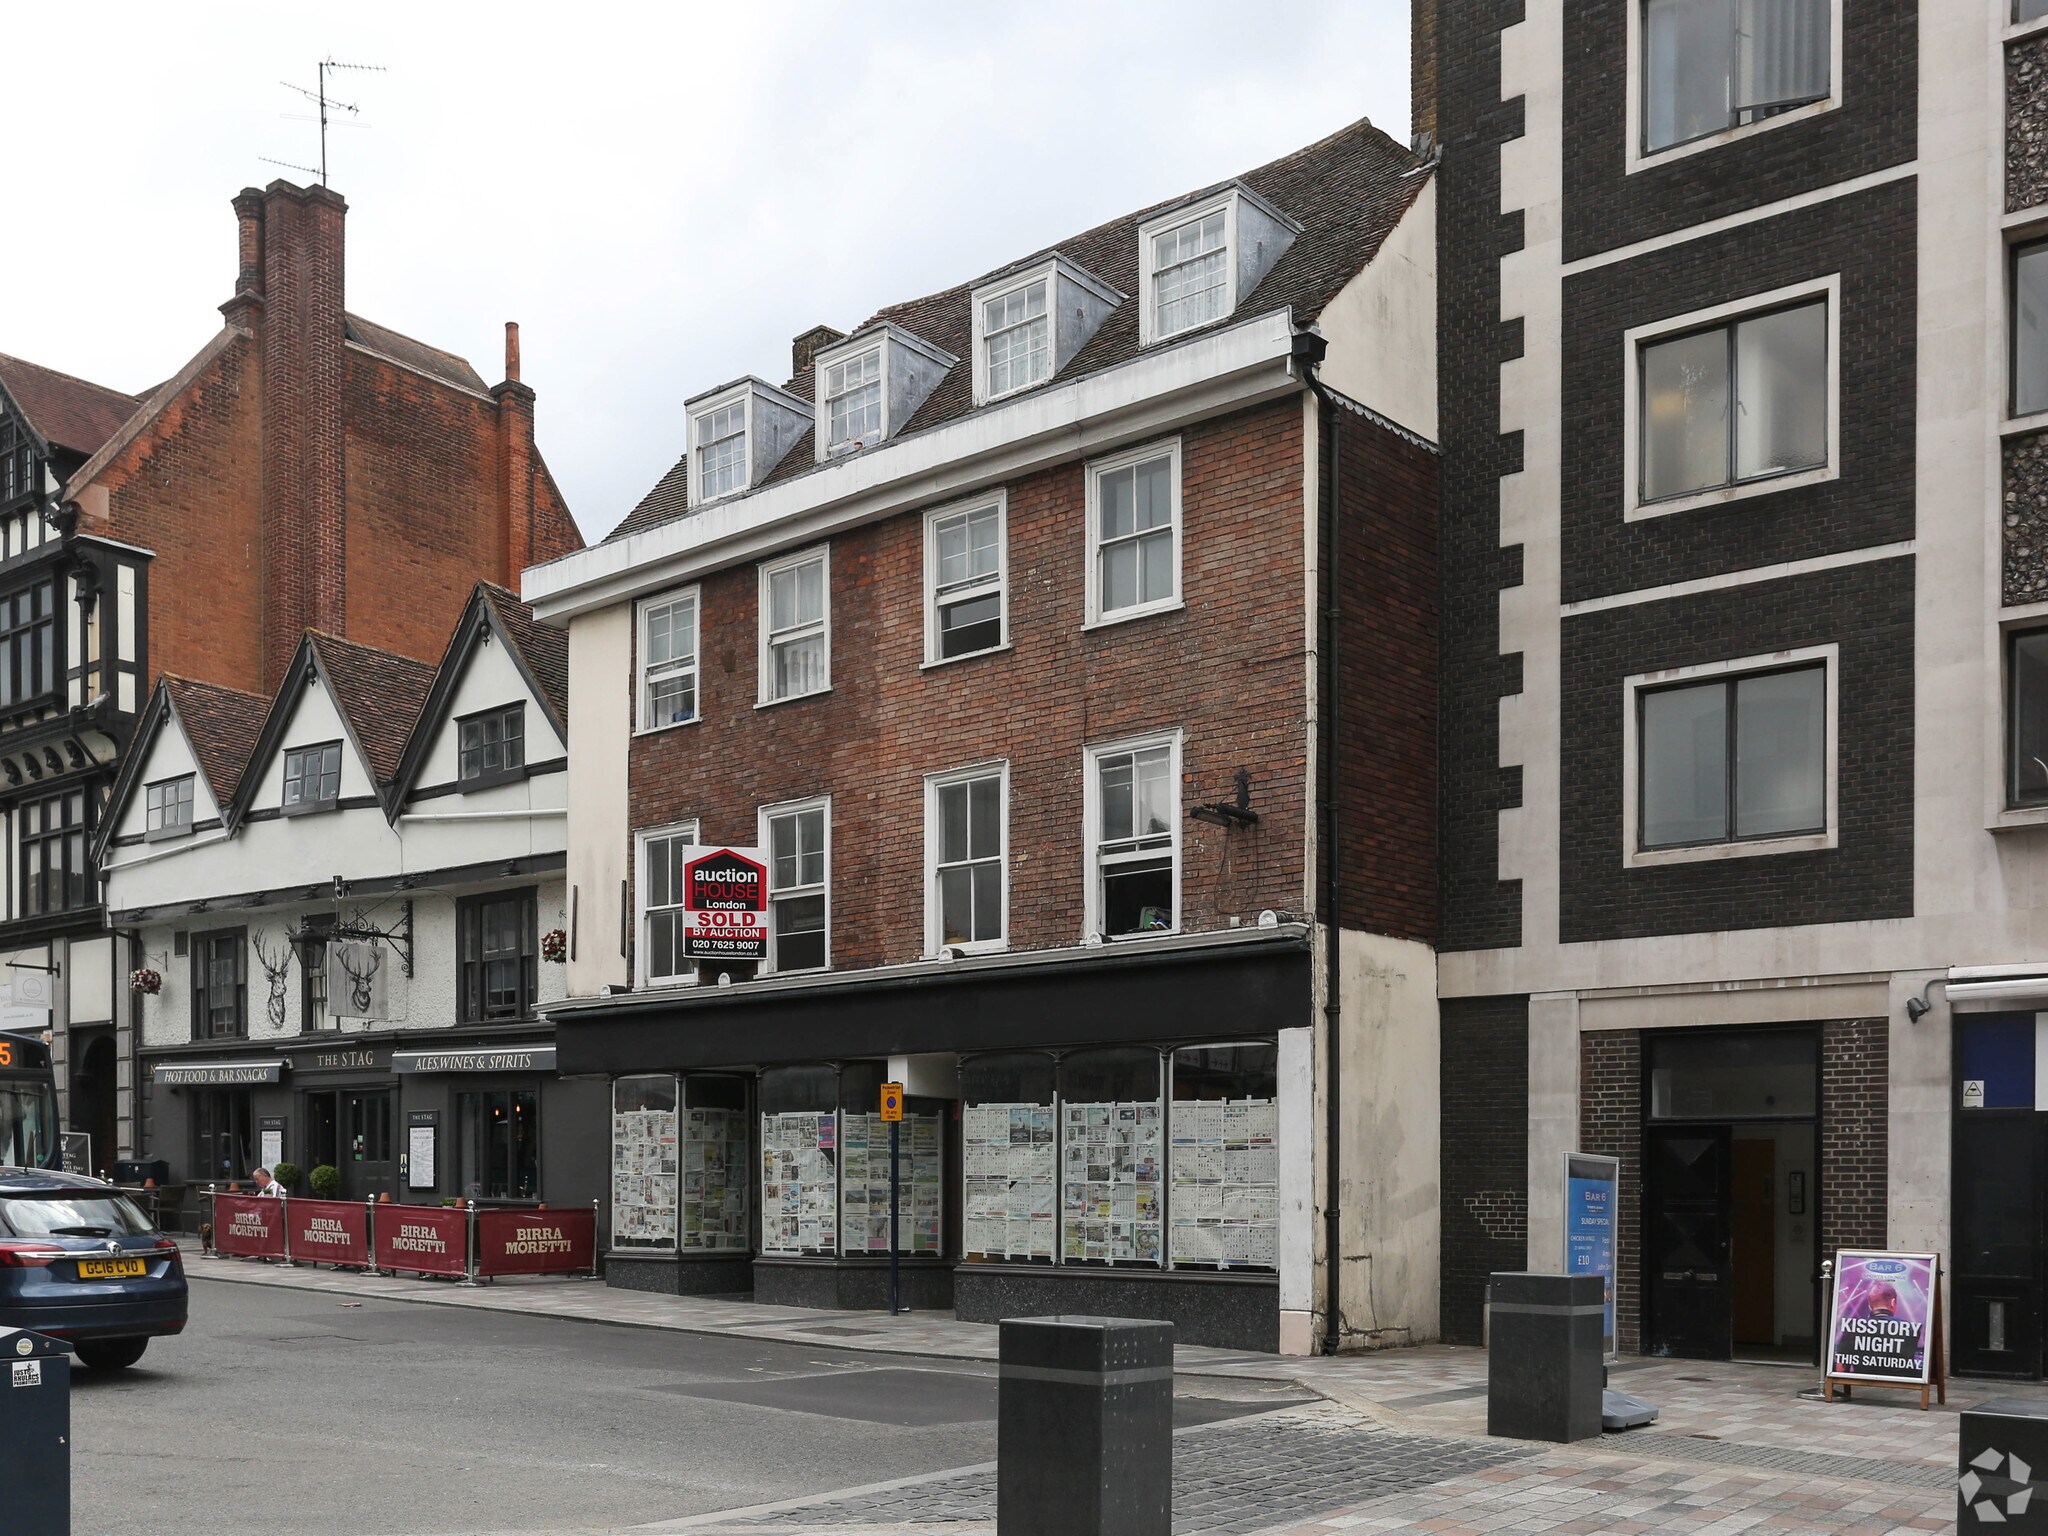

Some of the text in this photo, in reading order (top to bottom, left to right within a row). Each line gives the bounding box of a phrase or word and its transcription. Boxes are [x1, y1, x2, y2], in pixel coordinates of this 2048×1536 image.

[694, 868, 758, 883] auction
[695, 883, 758, 899] HOUSE
[706, 900, 746, 910] London
[698, 912, 756, 927] SOLD
[693, 928, 760, 938] BY AUCTION
[692, 940, 760, 950] 020 7625 9007
[317, 1050, 374, 1067] THE STAG
[476, 1055, 485, 1069] &
[489, 1053, 531, 1069] SPIRITS
[164, 1068, 268, 1082] HOT FOOD & BAR SNACKS
[1601, 1192, 1607, 1202] 6
[235, 1213, 262, 1226] BIRRA
[311, 1218, 343, 1232] BIRRA
[229, 1224, 269, 1239] MORETTI
[304, 1230, 351, 1246] MORETTI
[400, 1225, 438, 1240] BIRRA
[516, 1227, 563, 1241] BIRRA
[392, 1237, 446, 1254] MORETTI
[505, 1240, 572, 1255] MORETTI
[86, 1260, 139, 1275] GC16 CVO
[1578, 1255, 1590, 1265] £10
[1869, 1262, 1903, 1272] BAR 6
[1841, 1317, 1922, 1337] KISSTORY
[1854, 1335, 1905, 1353] NIGHT
[1835, 1353, 1923, 1370] THIS SATURDAY
